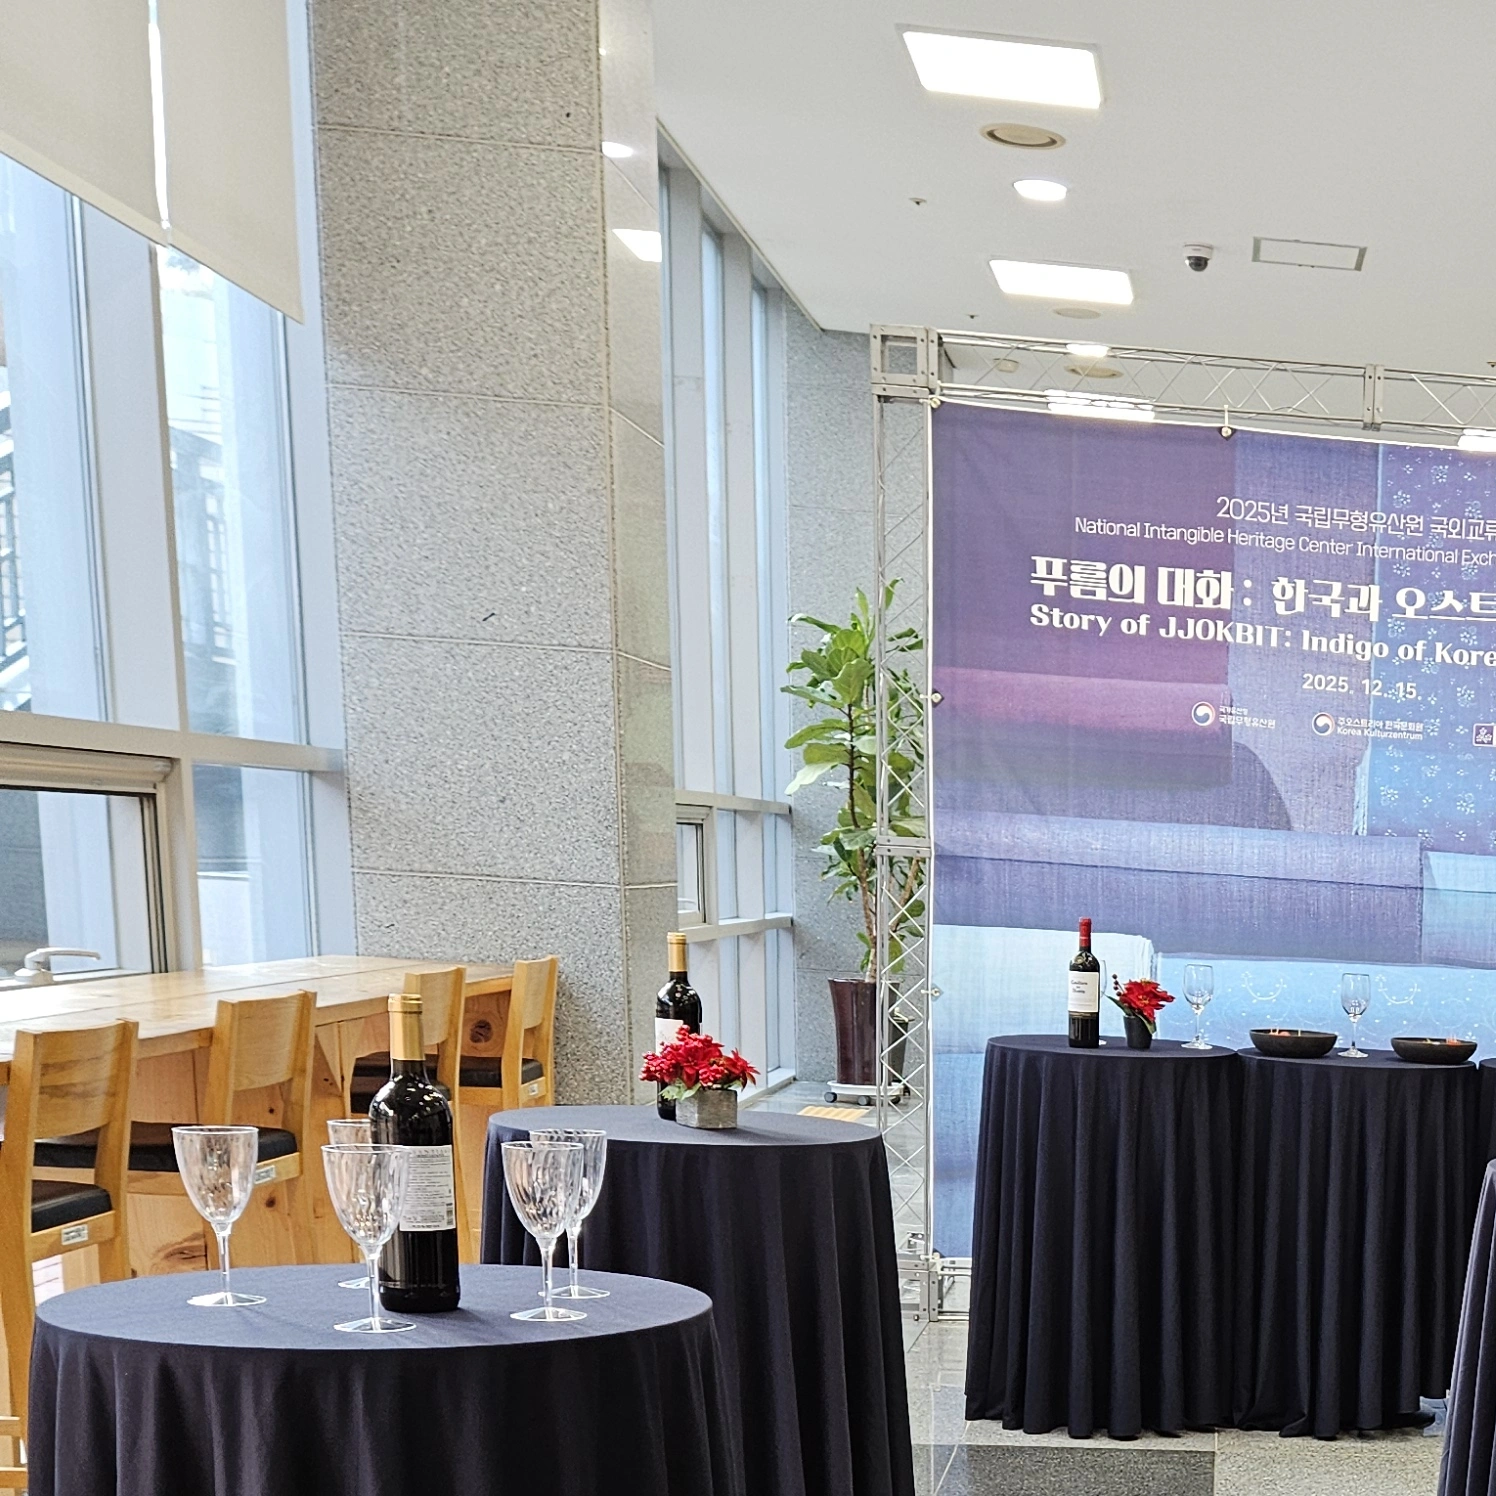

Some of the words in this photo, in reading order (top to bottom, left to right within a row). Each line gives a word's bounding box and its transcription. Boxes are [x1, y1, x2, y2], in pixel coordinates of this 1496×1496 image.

[1216, 496, 1289, 525] 2025년
[1294, 504, 1424, 537] 국립무형유산원
[1074, 516, 1141, 538] National
[1143, 522, 1225, 545] Intangible
[1226, 528, 1296, 552] Heritage
[1298, 536, 1354, 556] Center
[1355, 541, 1459, 564] International
[1029, 555, 1146, 604] 푸름의
[1271, 576, 1384, 622] 한국과
[1029, 603, 1113, 637] Story
[1120, 613, 1151, 636] of
[1158, 616, 1292, 648] JJOKBIT:
[1302, 629, 1390, 661] Indigo
[1397, 639, 1428, 661] of
[1301, 673, 1354, 695] 2025.
[1336, 726, 1361, 736] Korea
[1363, 728, 1424, 741] Kulturzentrum
